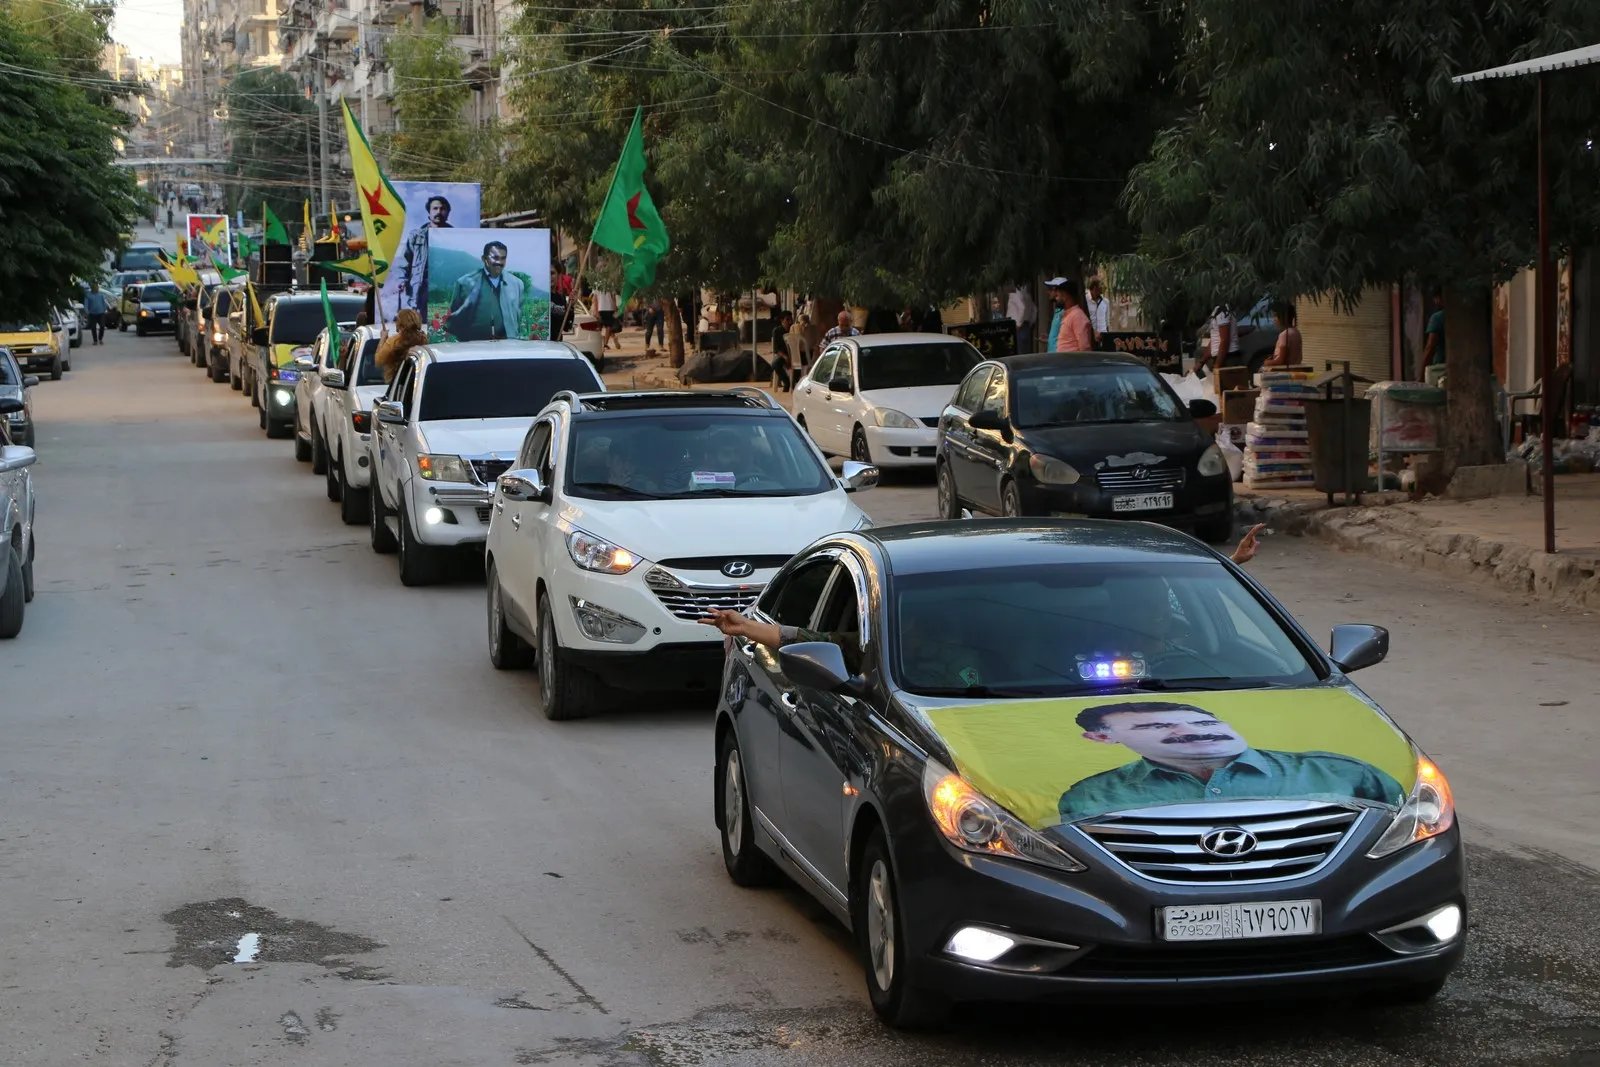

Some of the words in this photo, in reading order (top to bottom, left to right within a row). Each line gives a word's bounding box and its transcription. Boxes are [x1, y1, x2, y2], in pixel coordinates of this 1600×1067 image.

[1171, 909, 1219, 923] اللاذقية
[1243, 906, 1310, 932] ٦٧٩٥٢٧
[1171, 924, 1221, 936] 679527
